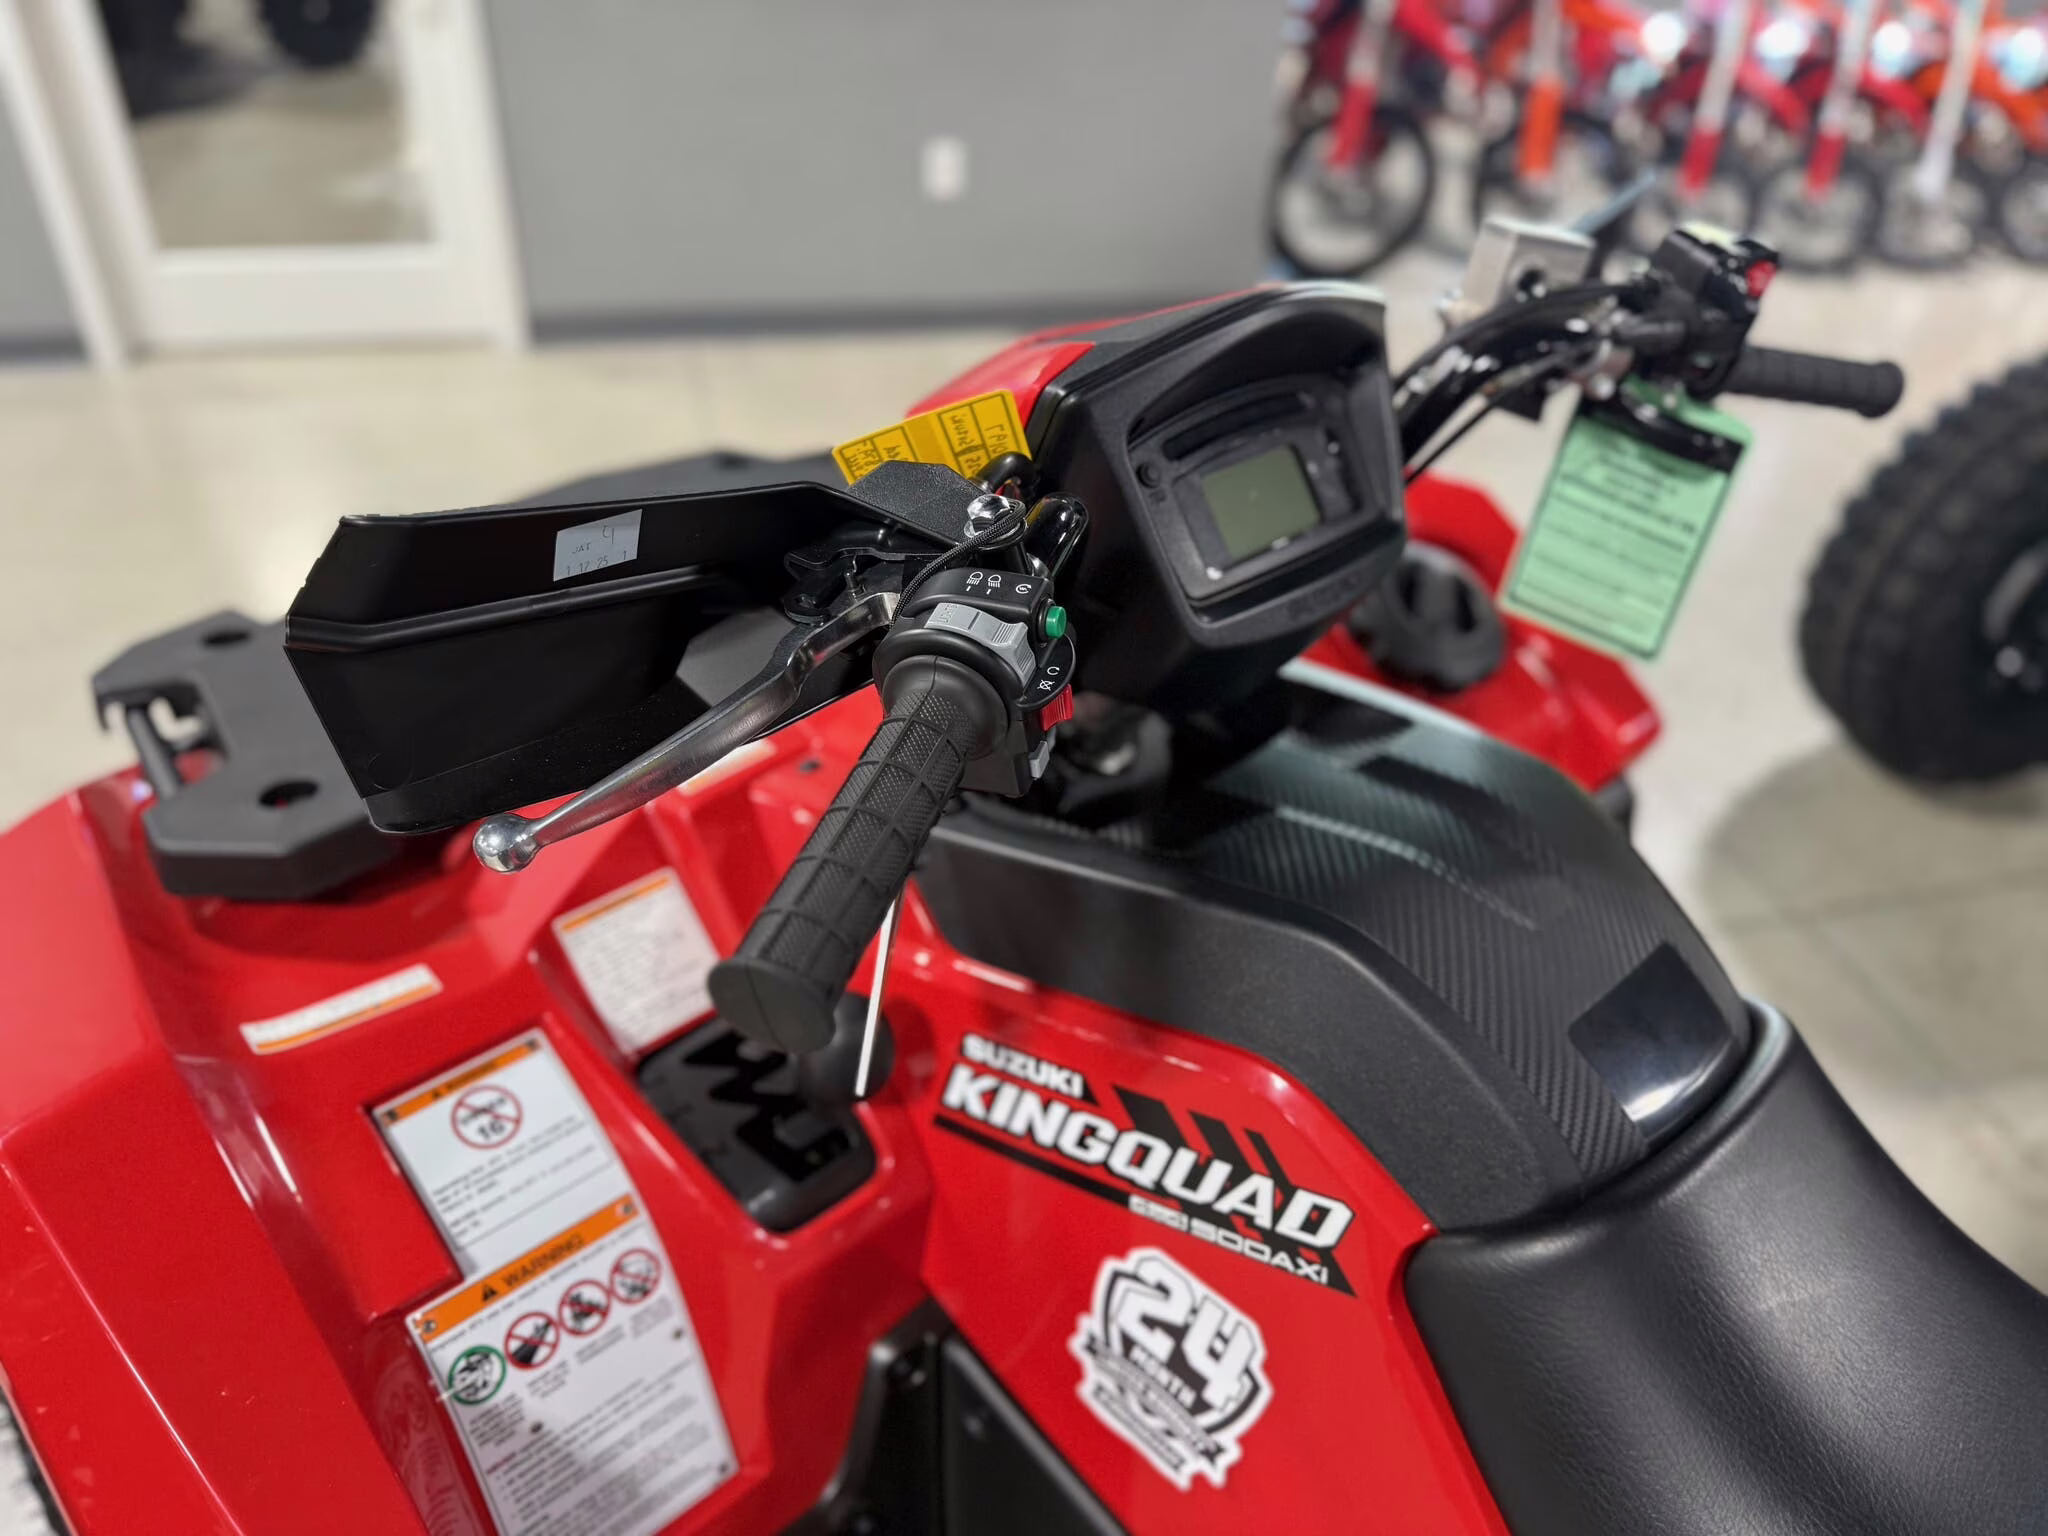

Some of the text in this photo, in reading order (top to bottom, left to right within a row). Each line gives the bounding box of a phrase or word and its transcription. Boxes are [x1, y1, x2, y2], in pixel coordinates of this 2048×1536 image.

[962, 1033, 1084, 1098] SUZUKI
[942, 1064, 1355, 1248] KINGQUAD
[1114, 1255, 1256, 1412] 24
